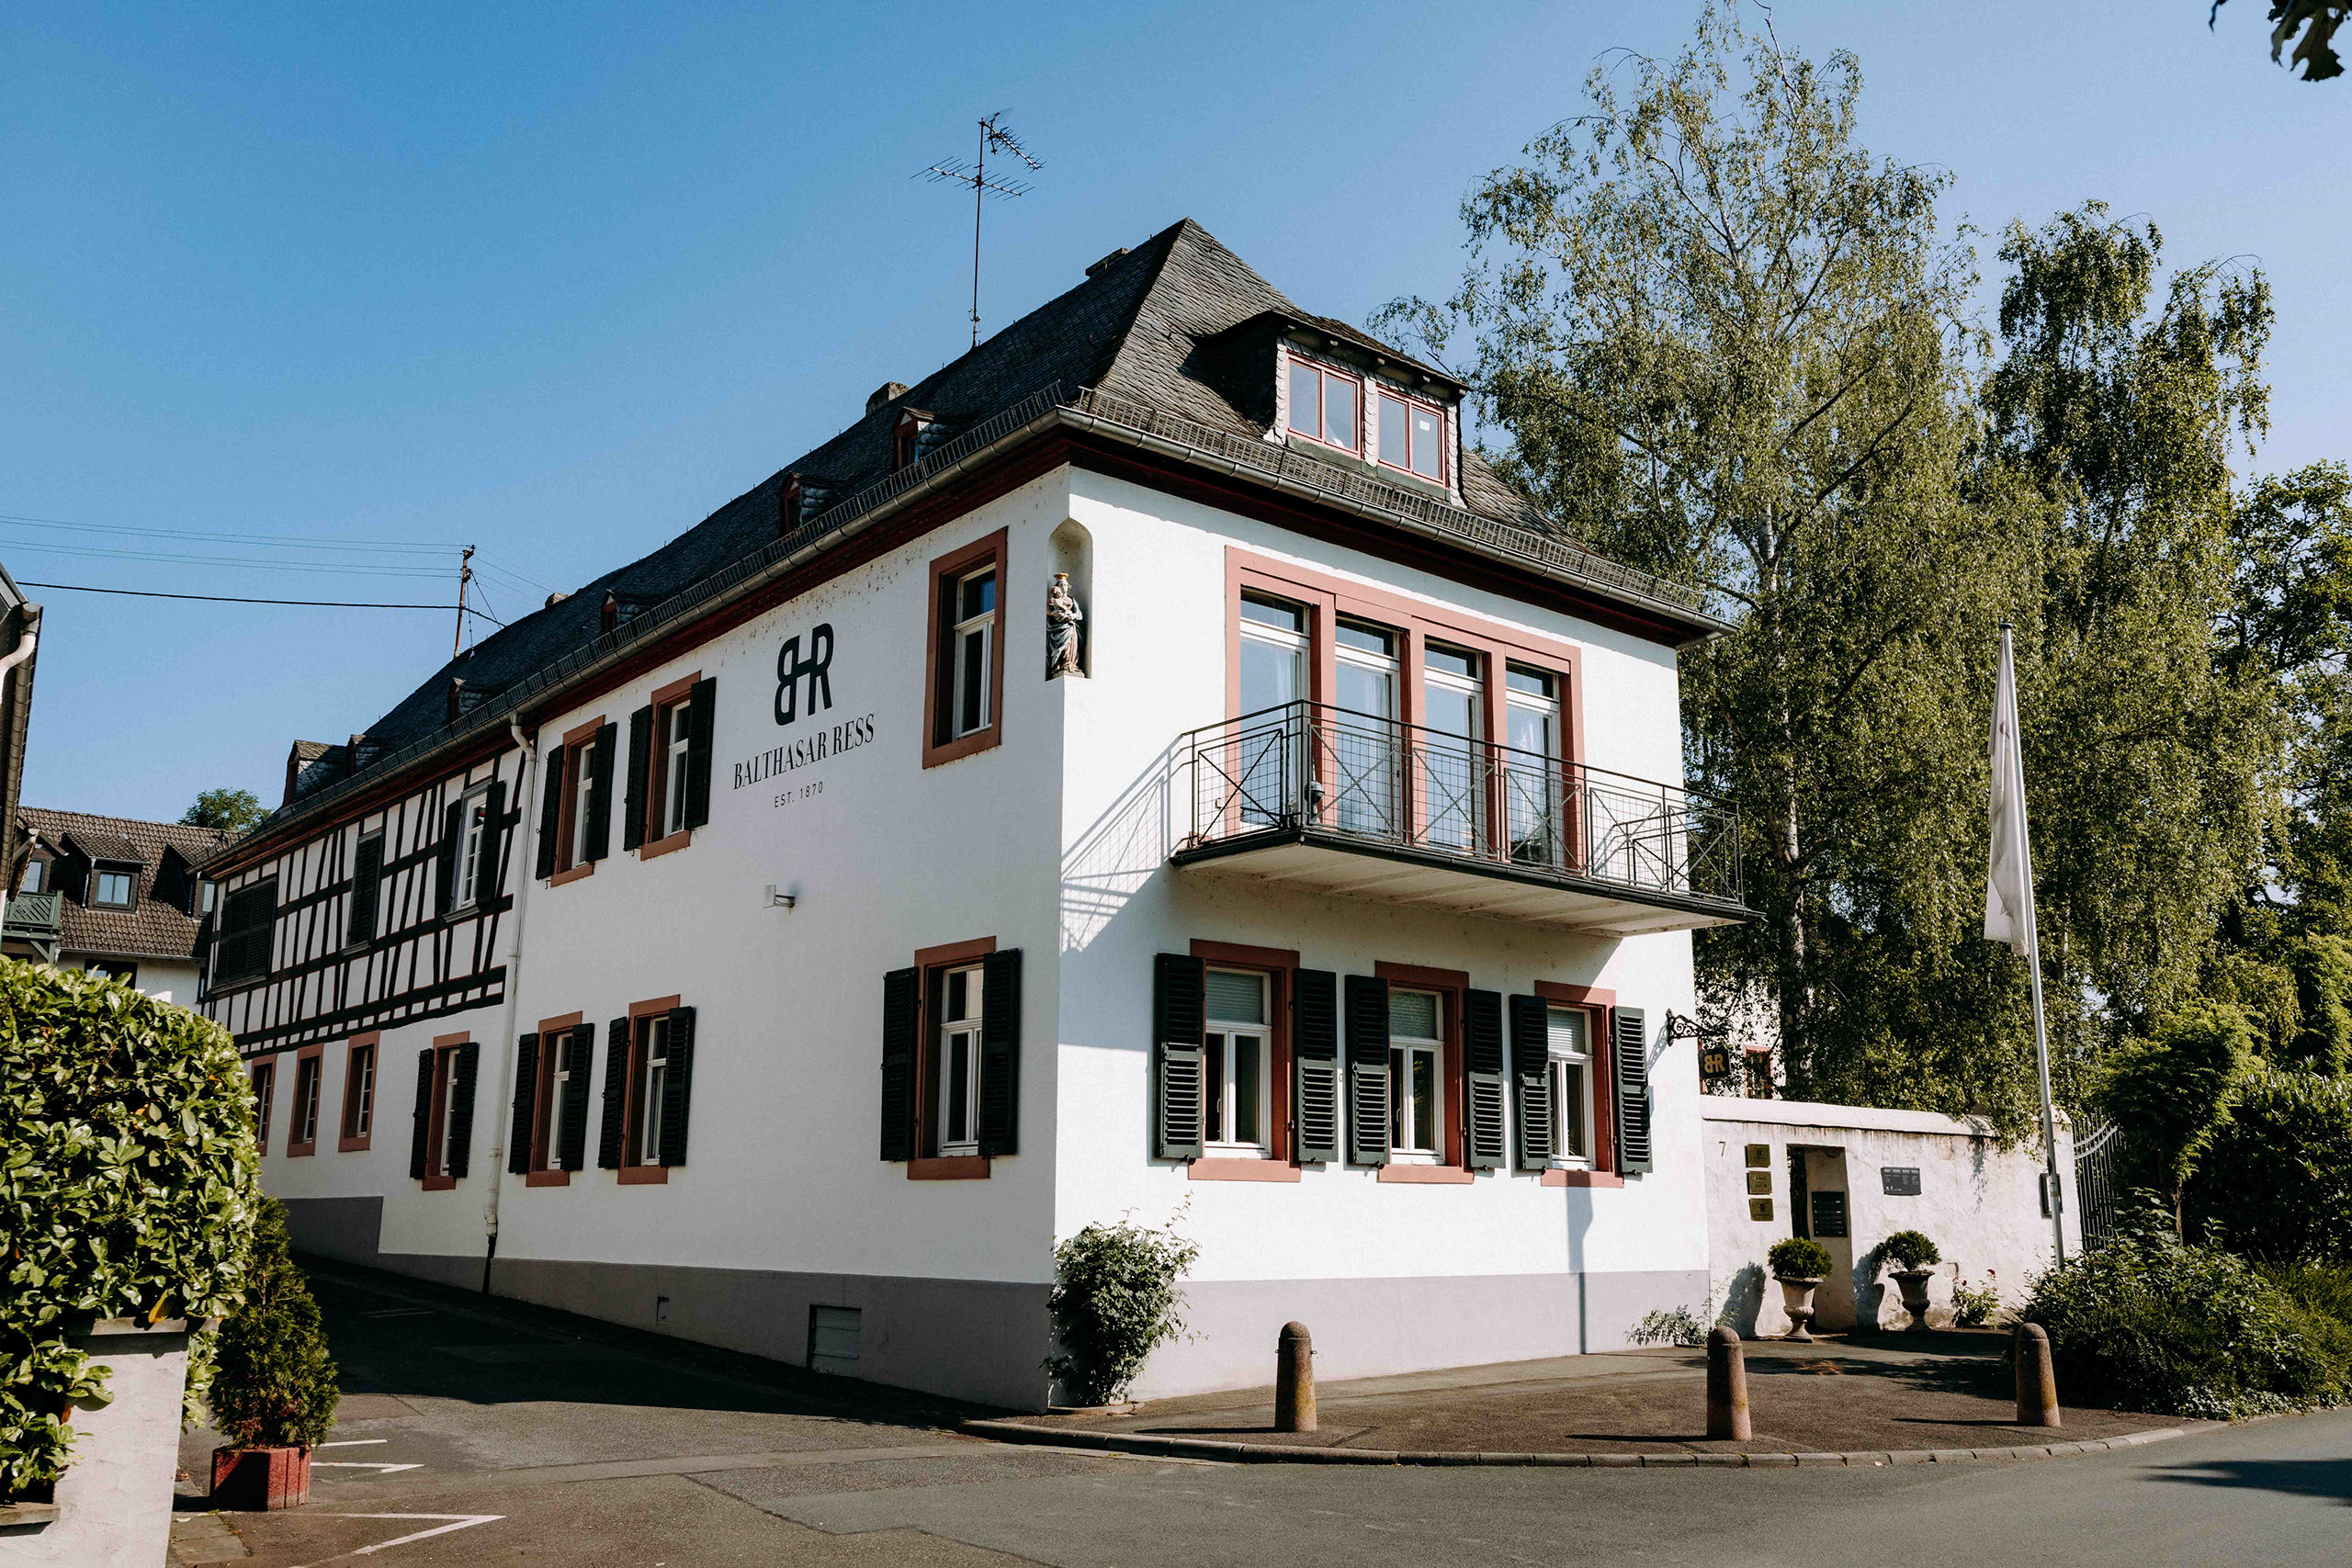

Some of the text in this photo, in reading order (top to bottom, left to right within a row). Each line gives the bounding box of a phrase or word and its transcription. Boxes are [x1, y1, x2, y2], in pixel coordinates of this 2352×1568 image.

[733, 713, 875, 790] BALTHASAR RESS
[775, 781, 823, 808] EST. 1870
[1718, 1141, 1726, 1157] 7
